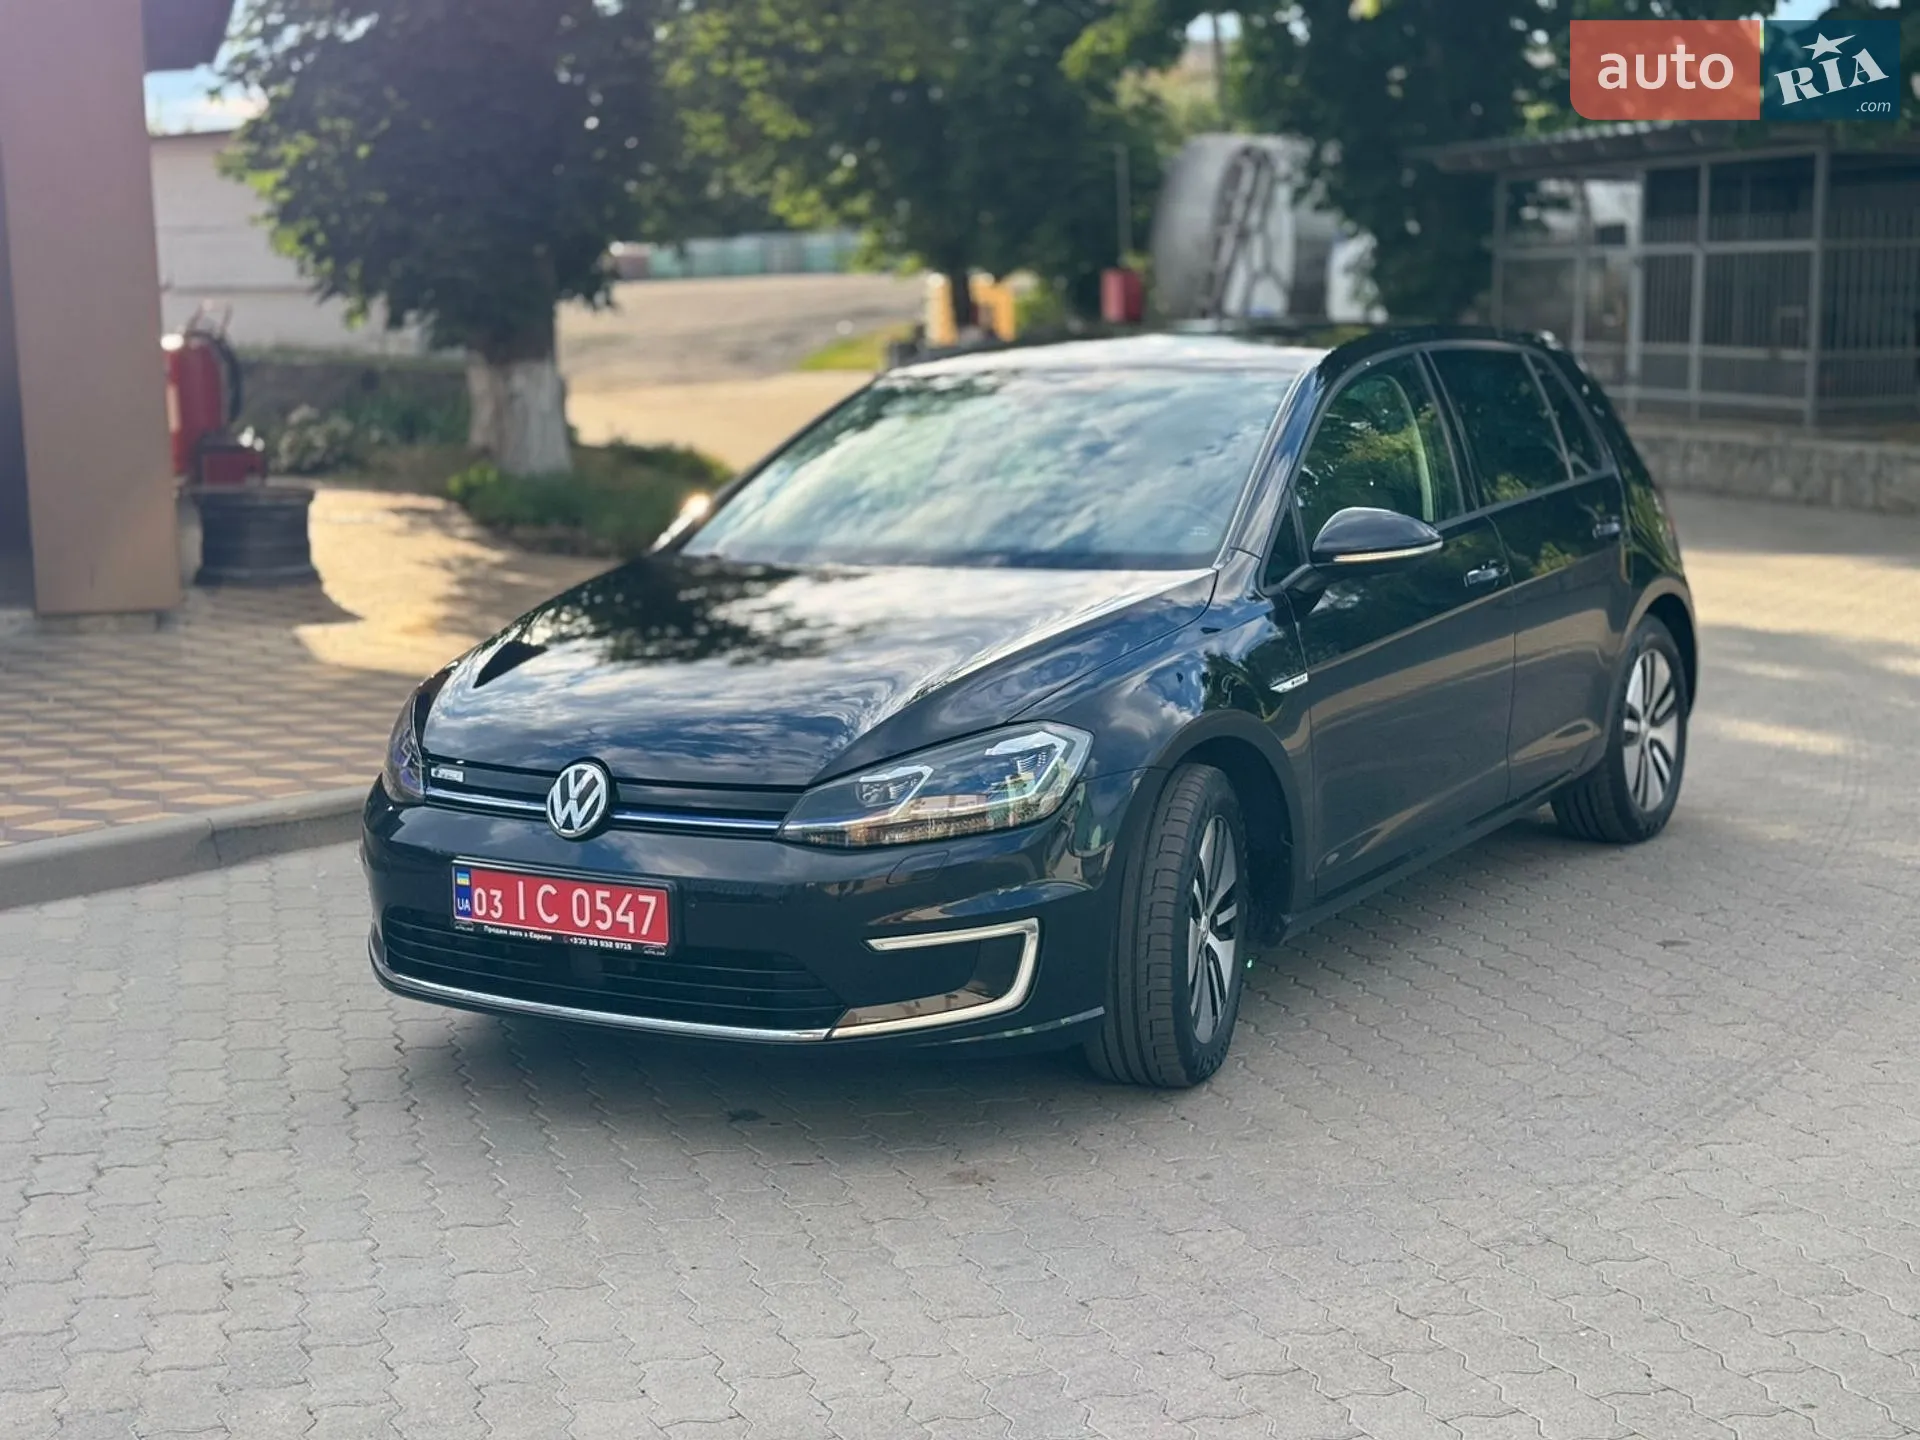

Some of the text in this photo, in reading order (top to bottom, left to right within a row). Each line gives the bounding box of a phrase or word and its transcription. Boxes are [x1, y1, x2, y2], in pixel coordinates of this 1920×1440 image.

[457, 897, 472, 912] UA
[474, 887, 503, 919] 03
[571, 888, 657, 935] 0547
